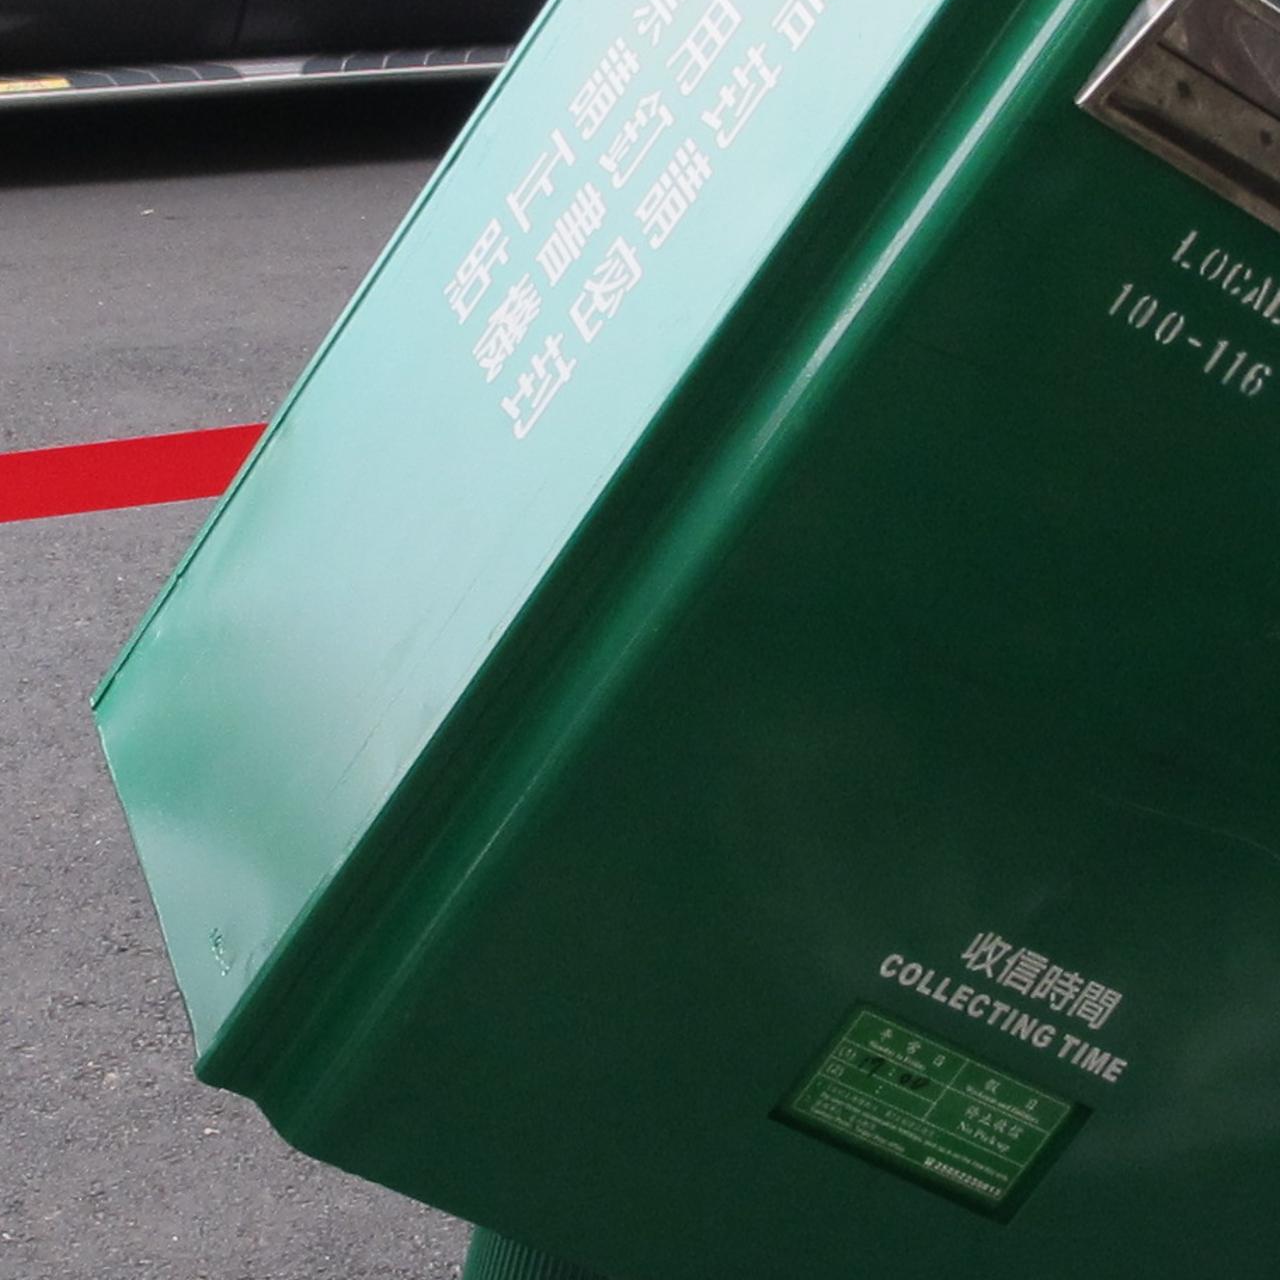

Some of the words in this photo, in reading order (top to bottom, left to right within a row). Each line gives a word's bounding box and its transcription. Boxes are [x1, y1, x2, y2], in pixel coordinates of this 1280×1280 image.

[1108, 283, 1272, 397] 100-116
[879, 953, 1058, 1049] COLLECTING
[1056, 1033, 1128, 1083] TIME
[961, 932, 1124, 1031] 收信時間
